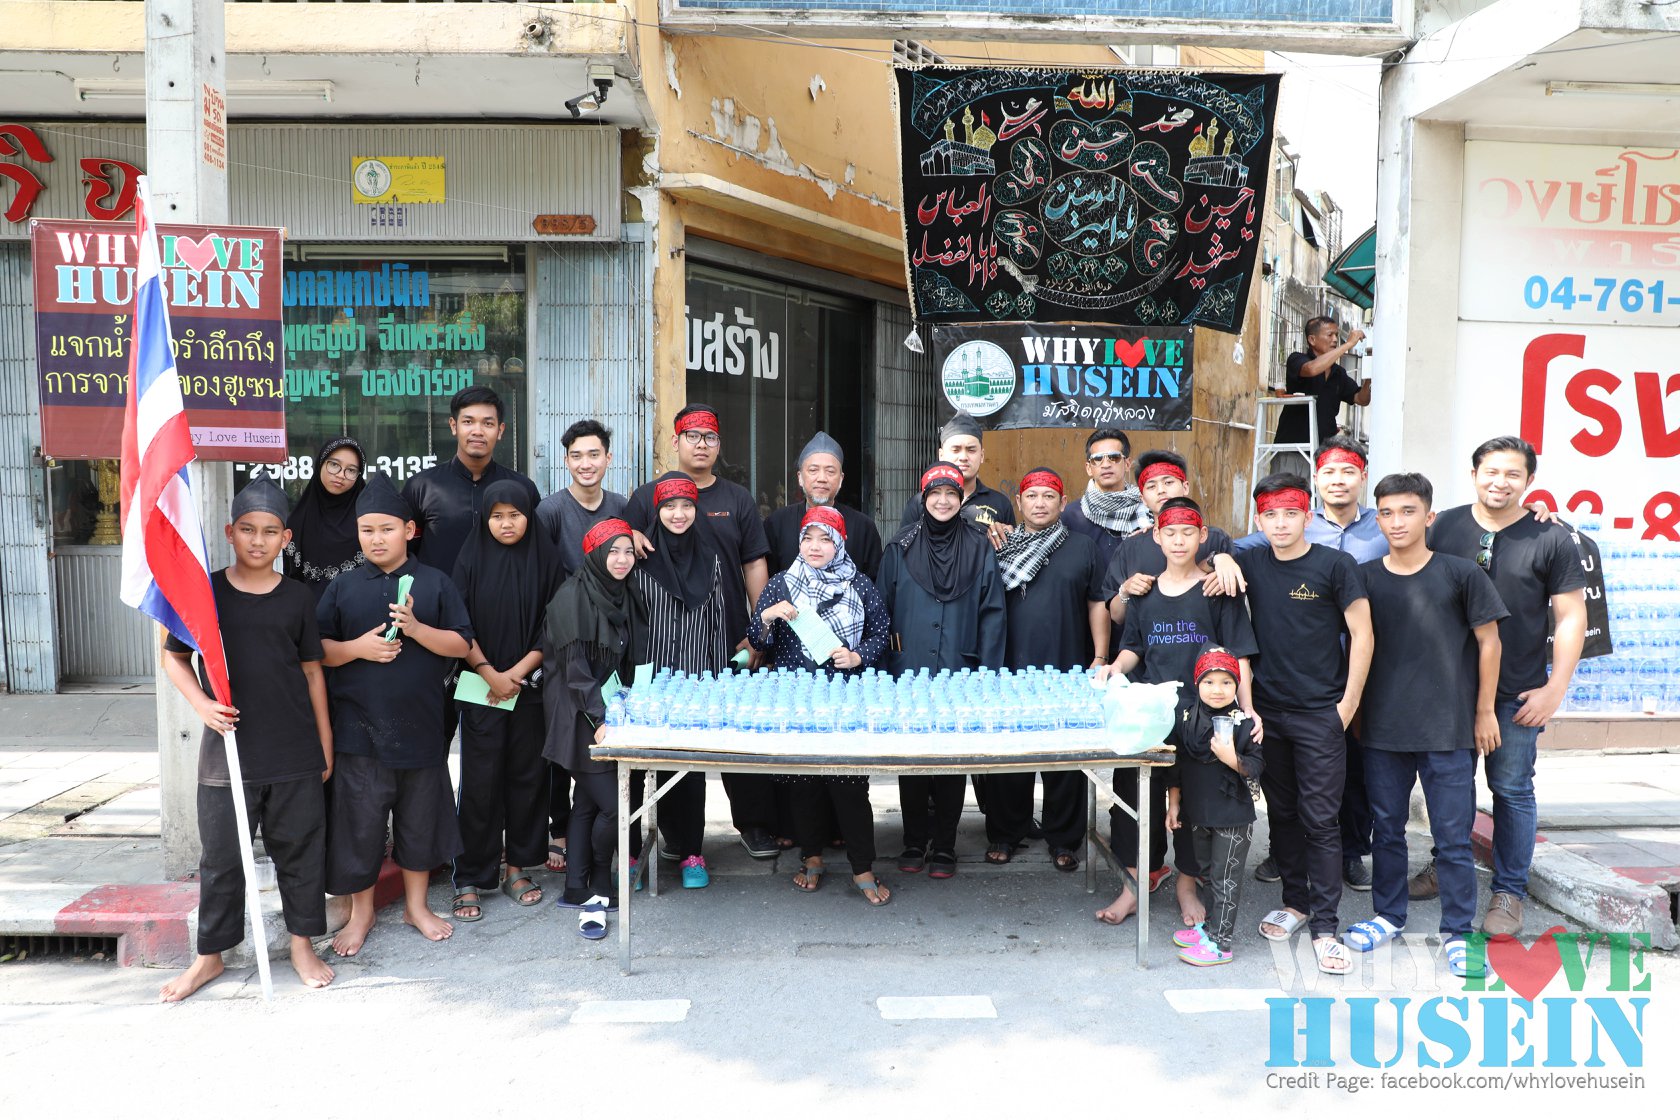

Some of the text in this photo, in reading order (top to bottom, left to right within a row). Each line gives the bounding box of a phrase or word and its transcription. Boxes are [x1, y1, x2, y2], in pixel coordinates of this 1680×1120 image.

[1021, 337, 1101, 364] WHY
[1022, 364, 1183, 398] HUSEIN
[209, 431, 237, 442] Love
[244, 432, 281, 444] Husein
[1176, 620, 1196, 631] the
